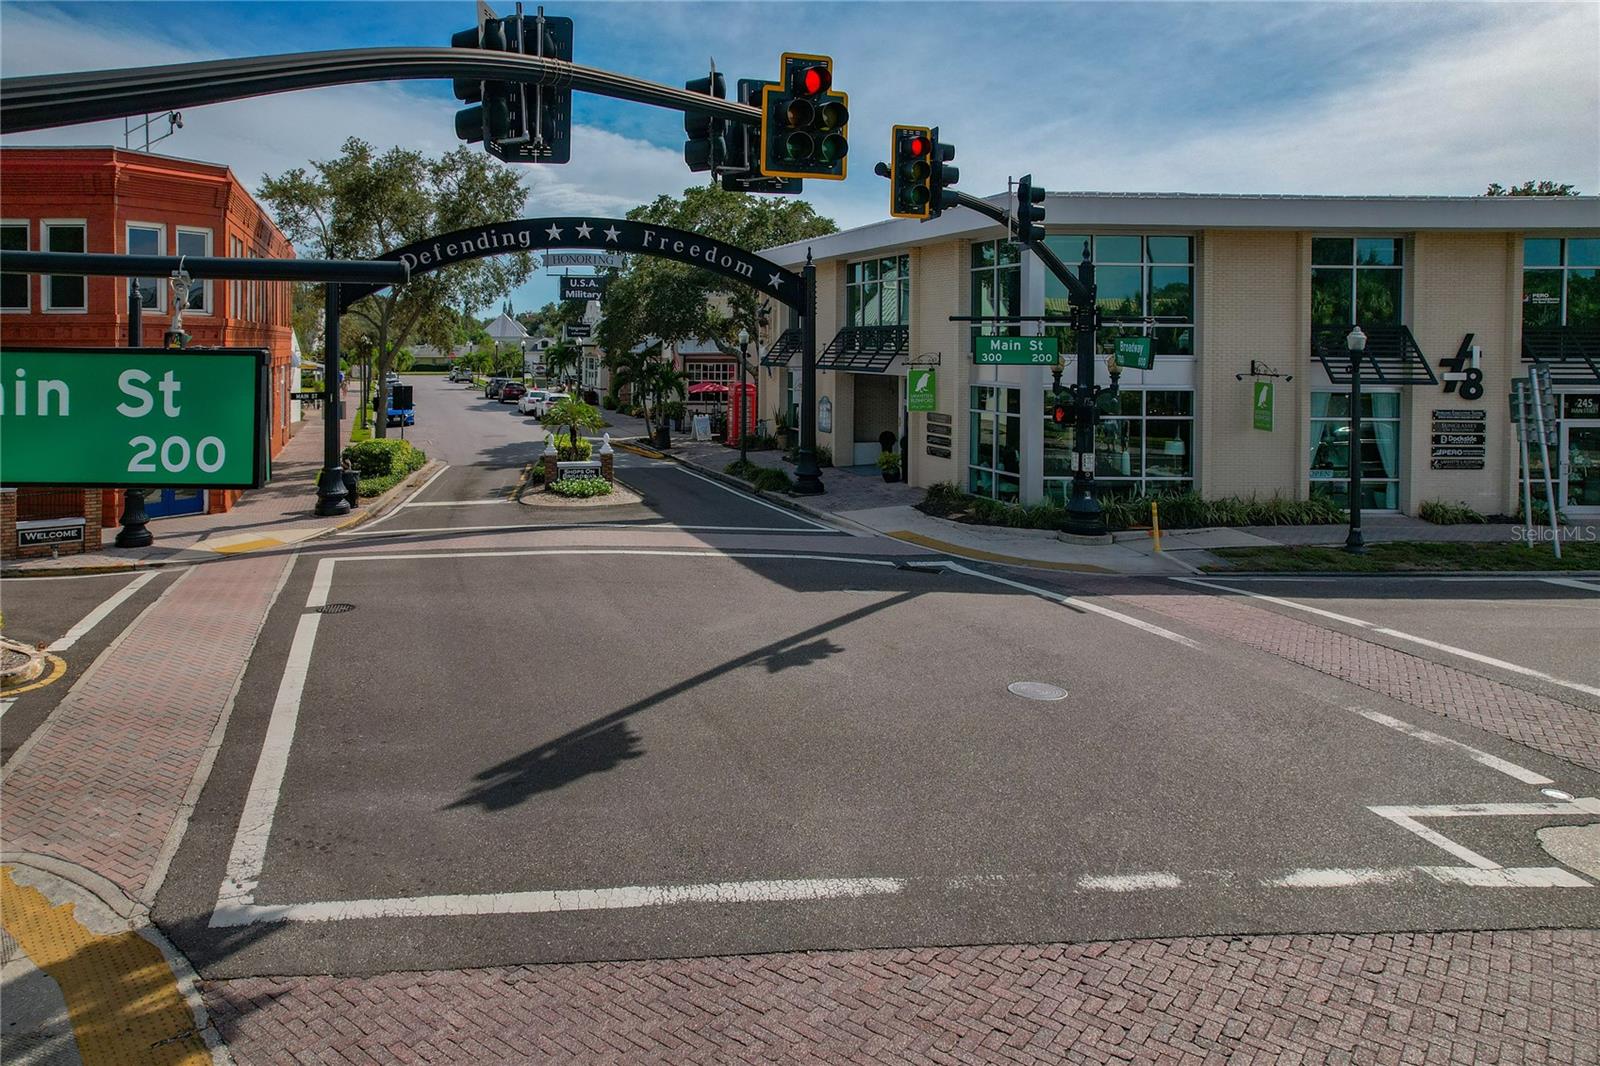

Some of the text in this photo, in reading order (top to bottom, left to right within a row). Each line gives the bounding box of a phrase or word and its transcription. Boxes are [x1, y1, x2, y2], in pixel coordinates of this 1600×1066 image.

[400, 229, 754, 277] Defending Freedom
[552, 254, 614, 265] HONORING
[570, 279, 599, 287] U.S.A.
[565, 290, 602, 299] Military
[990, 339, 1044, 351] Main St
[1120, 340, 1144, 356] Broadway
[982, 353, 1052, 362] 300 200
[0, 368, 182, 418] in St
[1577, 399, 1593, 408] 245
[127, 435, 226, 473] 200
[25, 529, 78, 541] WELCOME
